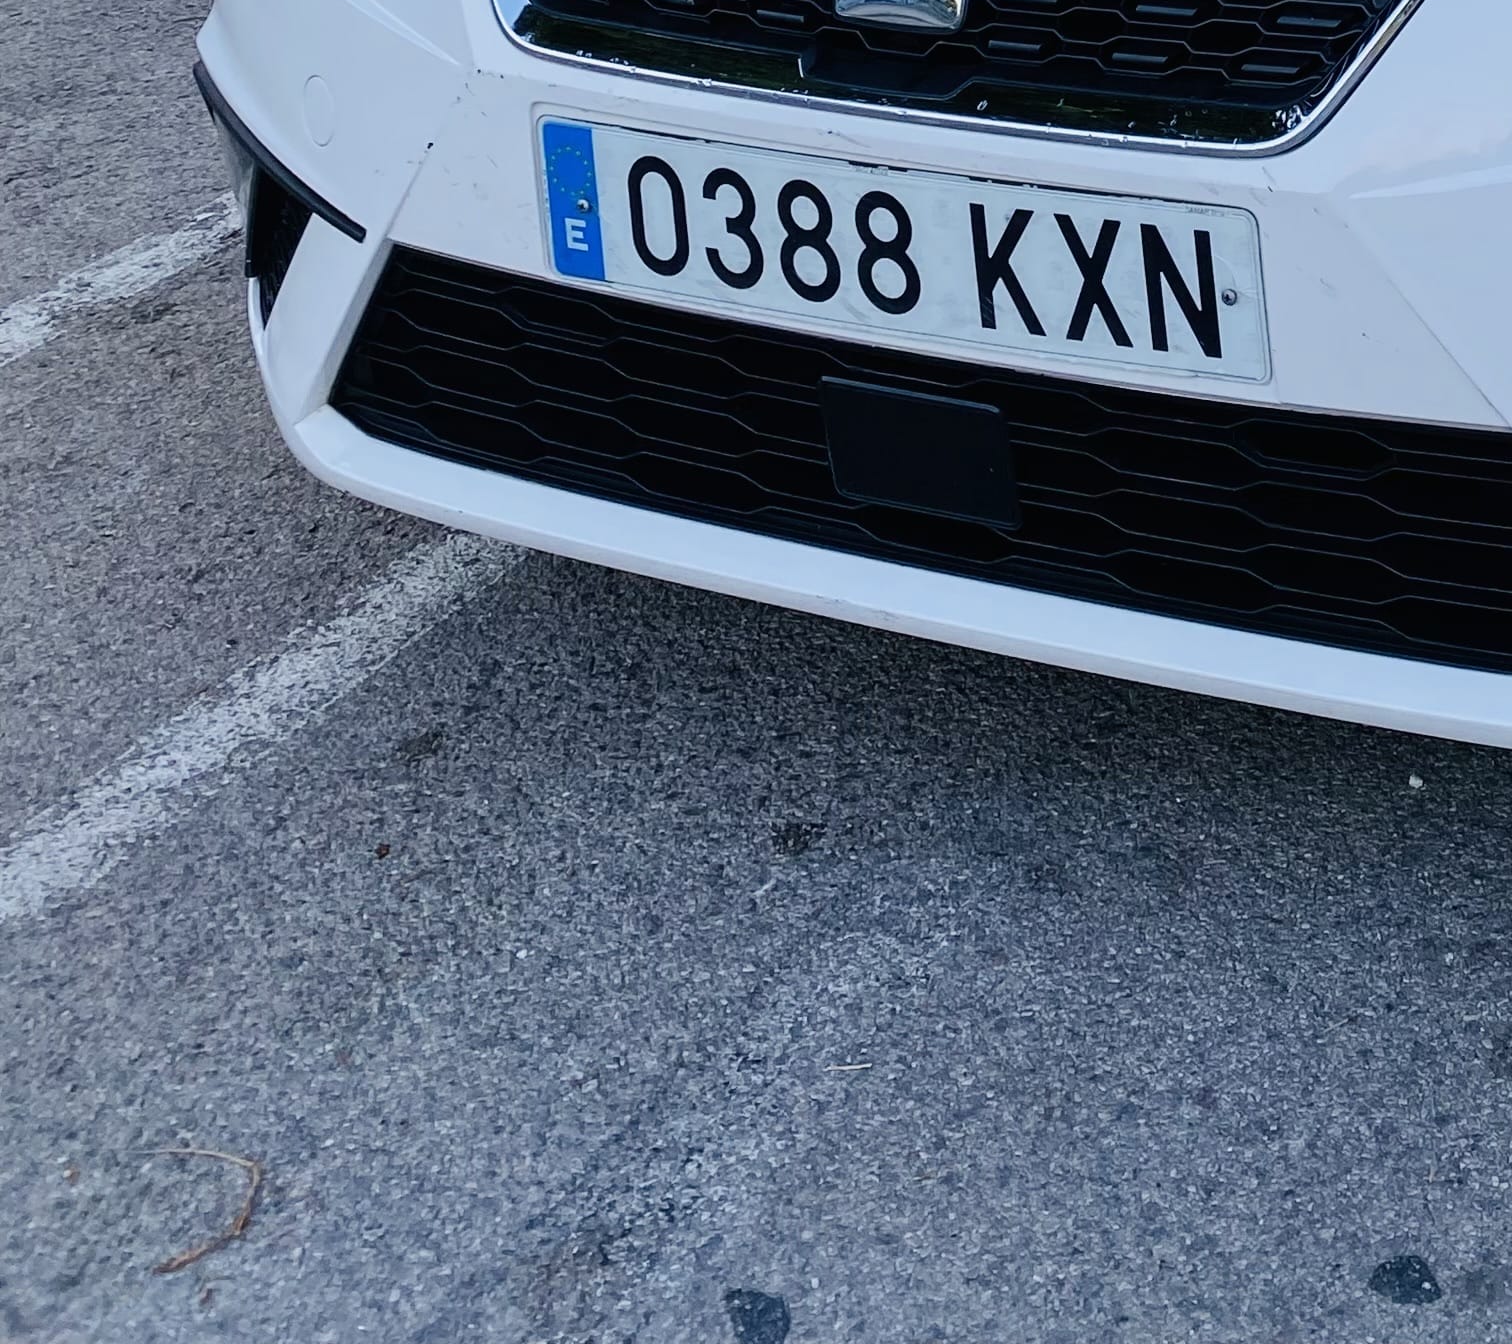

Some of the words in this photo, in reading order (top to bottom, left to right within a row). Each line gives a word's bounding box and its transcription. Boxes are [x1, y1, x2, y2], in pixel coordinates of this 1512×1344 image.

[564, 216, 589, 252] E
[627, 155, 922, 315] 0388
[969, 203, 1223, 358] KXN
